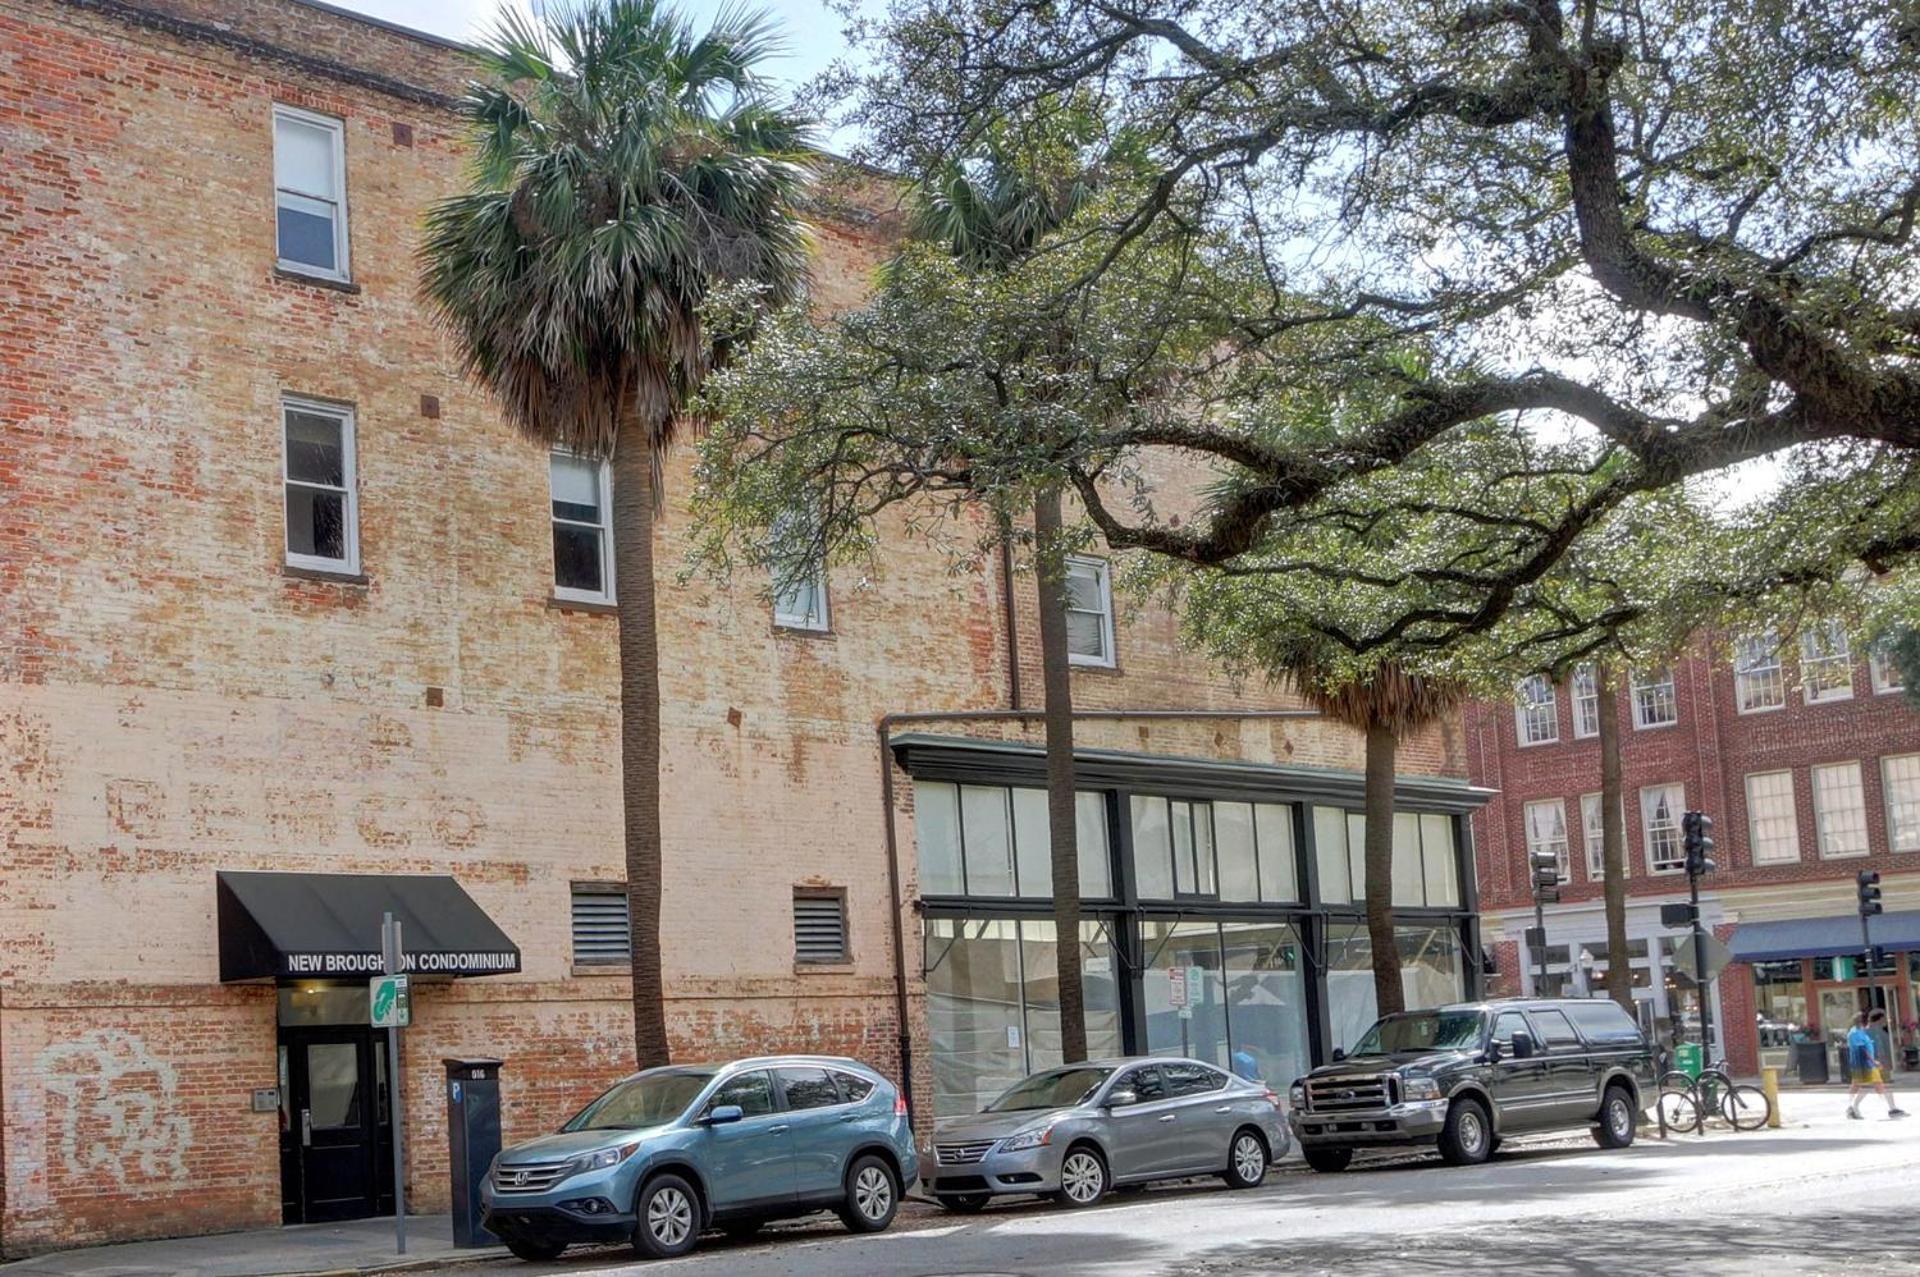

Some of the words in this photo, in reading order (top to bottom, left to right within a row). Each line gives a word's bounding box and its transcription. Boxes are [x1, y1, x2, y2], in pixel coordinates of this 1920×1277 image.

[288, 955, 322, 971] NEW
[325, 954, 416, 971] BROUGHON
[419, 953, 516, 970] CONDOMINIUM
